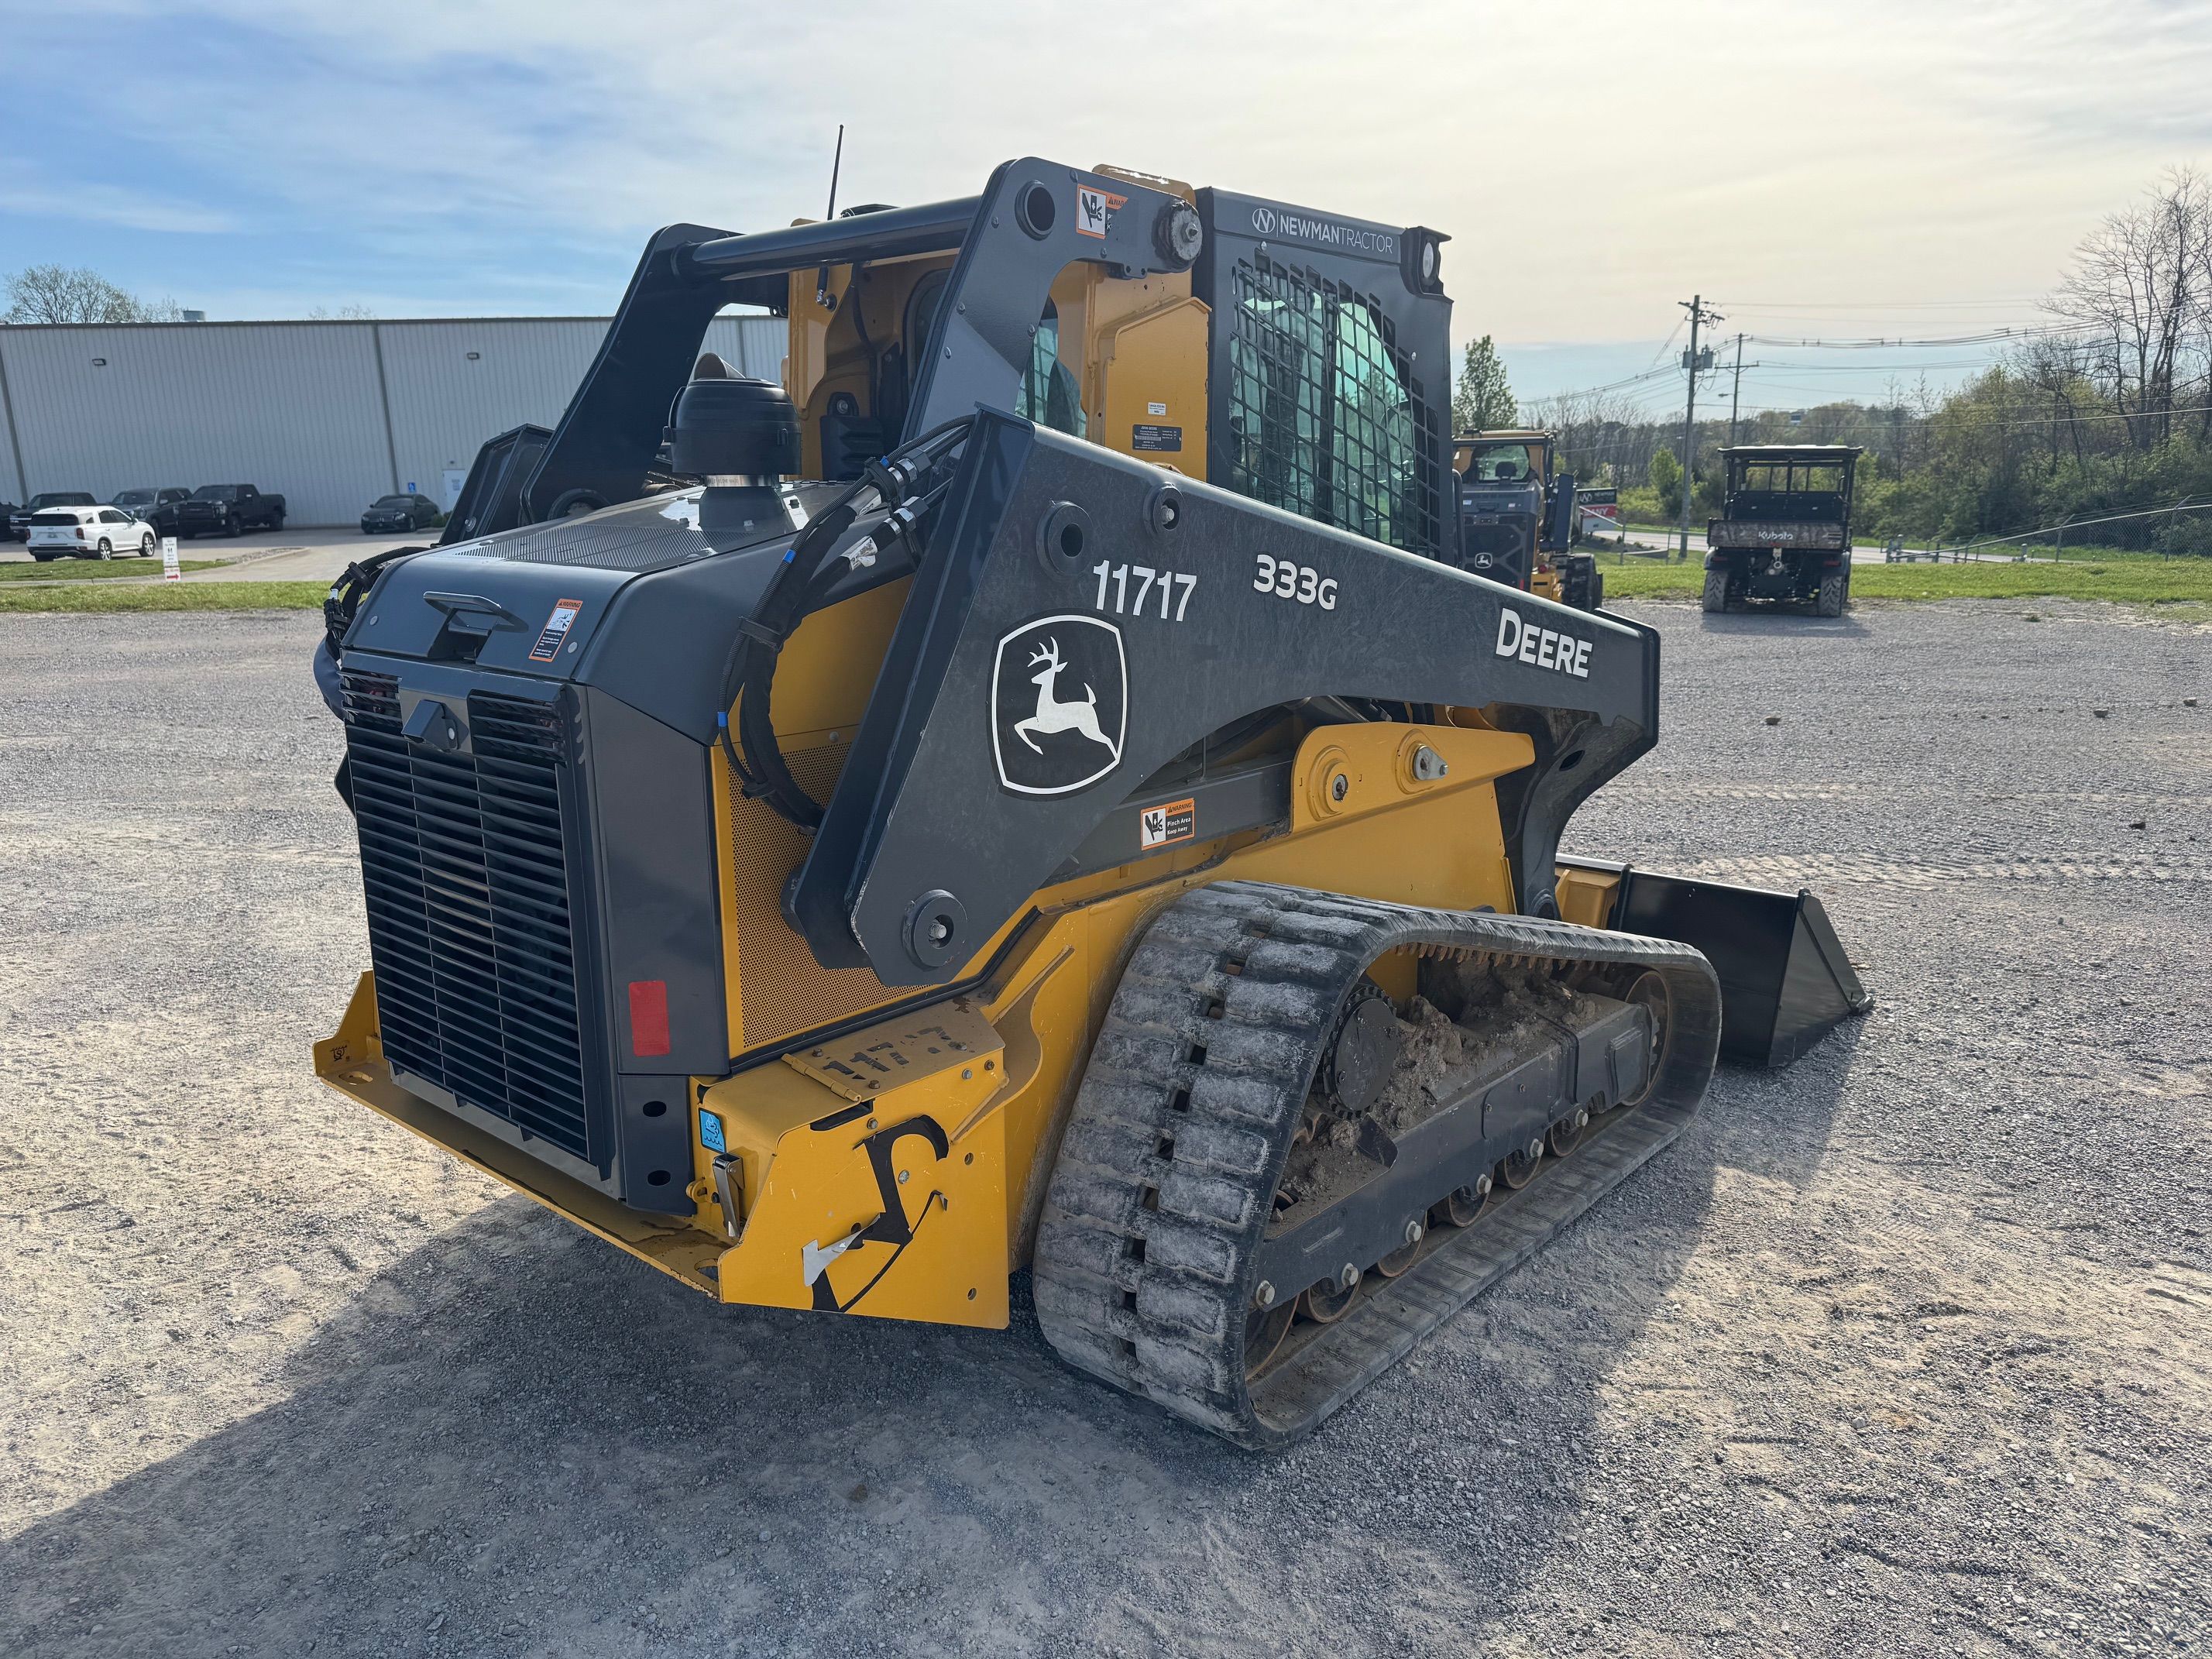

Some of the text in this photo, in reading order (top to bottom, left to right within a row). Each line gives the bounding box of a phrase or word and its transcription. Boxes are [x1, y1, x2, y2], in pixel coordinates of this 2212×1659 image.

[1758, 531, 1794, 540] Kubota
[1093, 559, 1197, 622] 11717
[1252, 554, 1338, 610] 333G
[1496, 607, 1593, 678] DEERE
[1167, 819, 1180, 827] Pinch
[1172, 802, 1192, 812] WARNING
